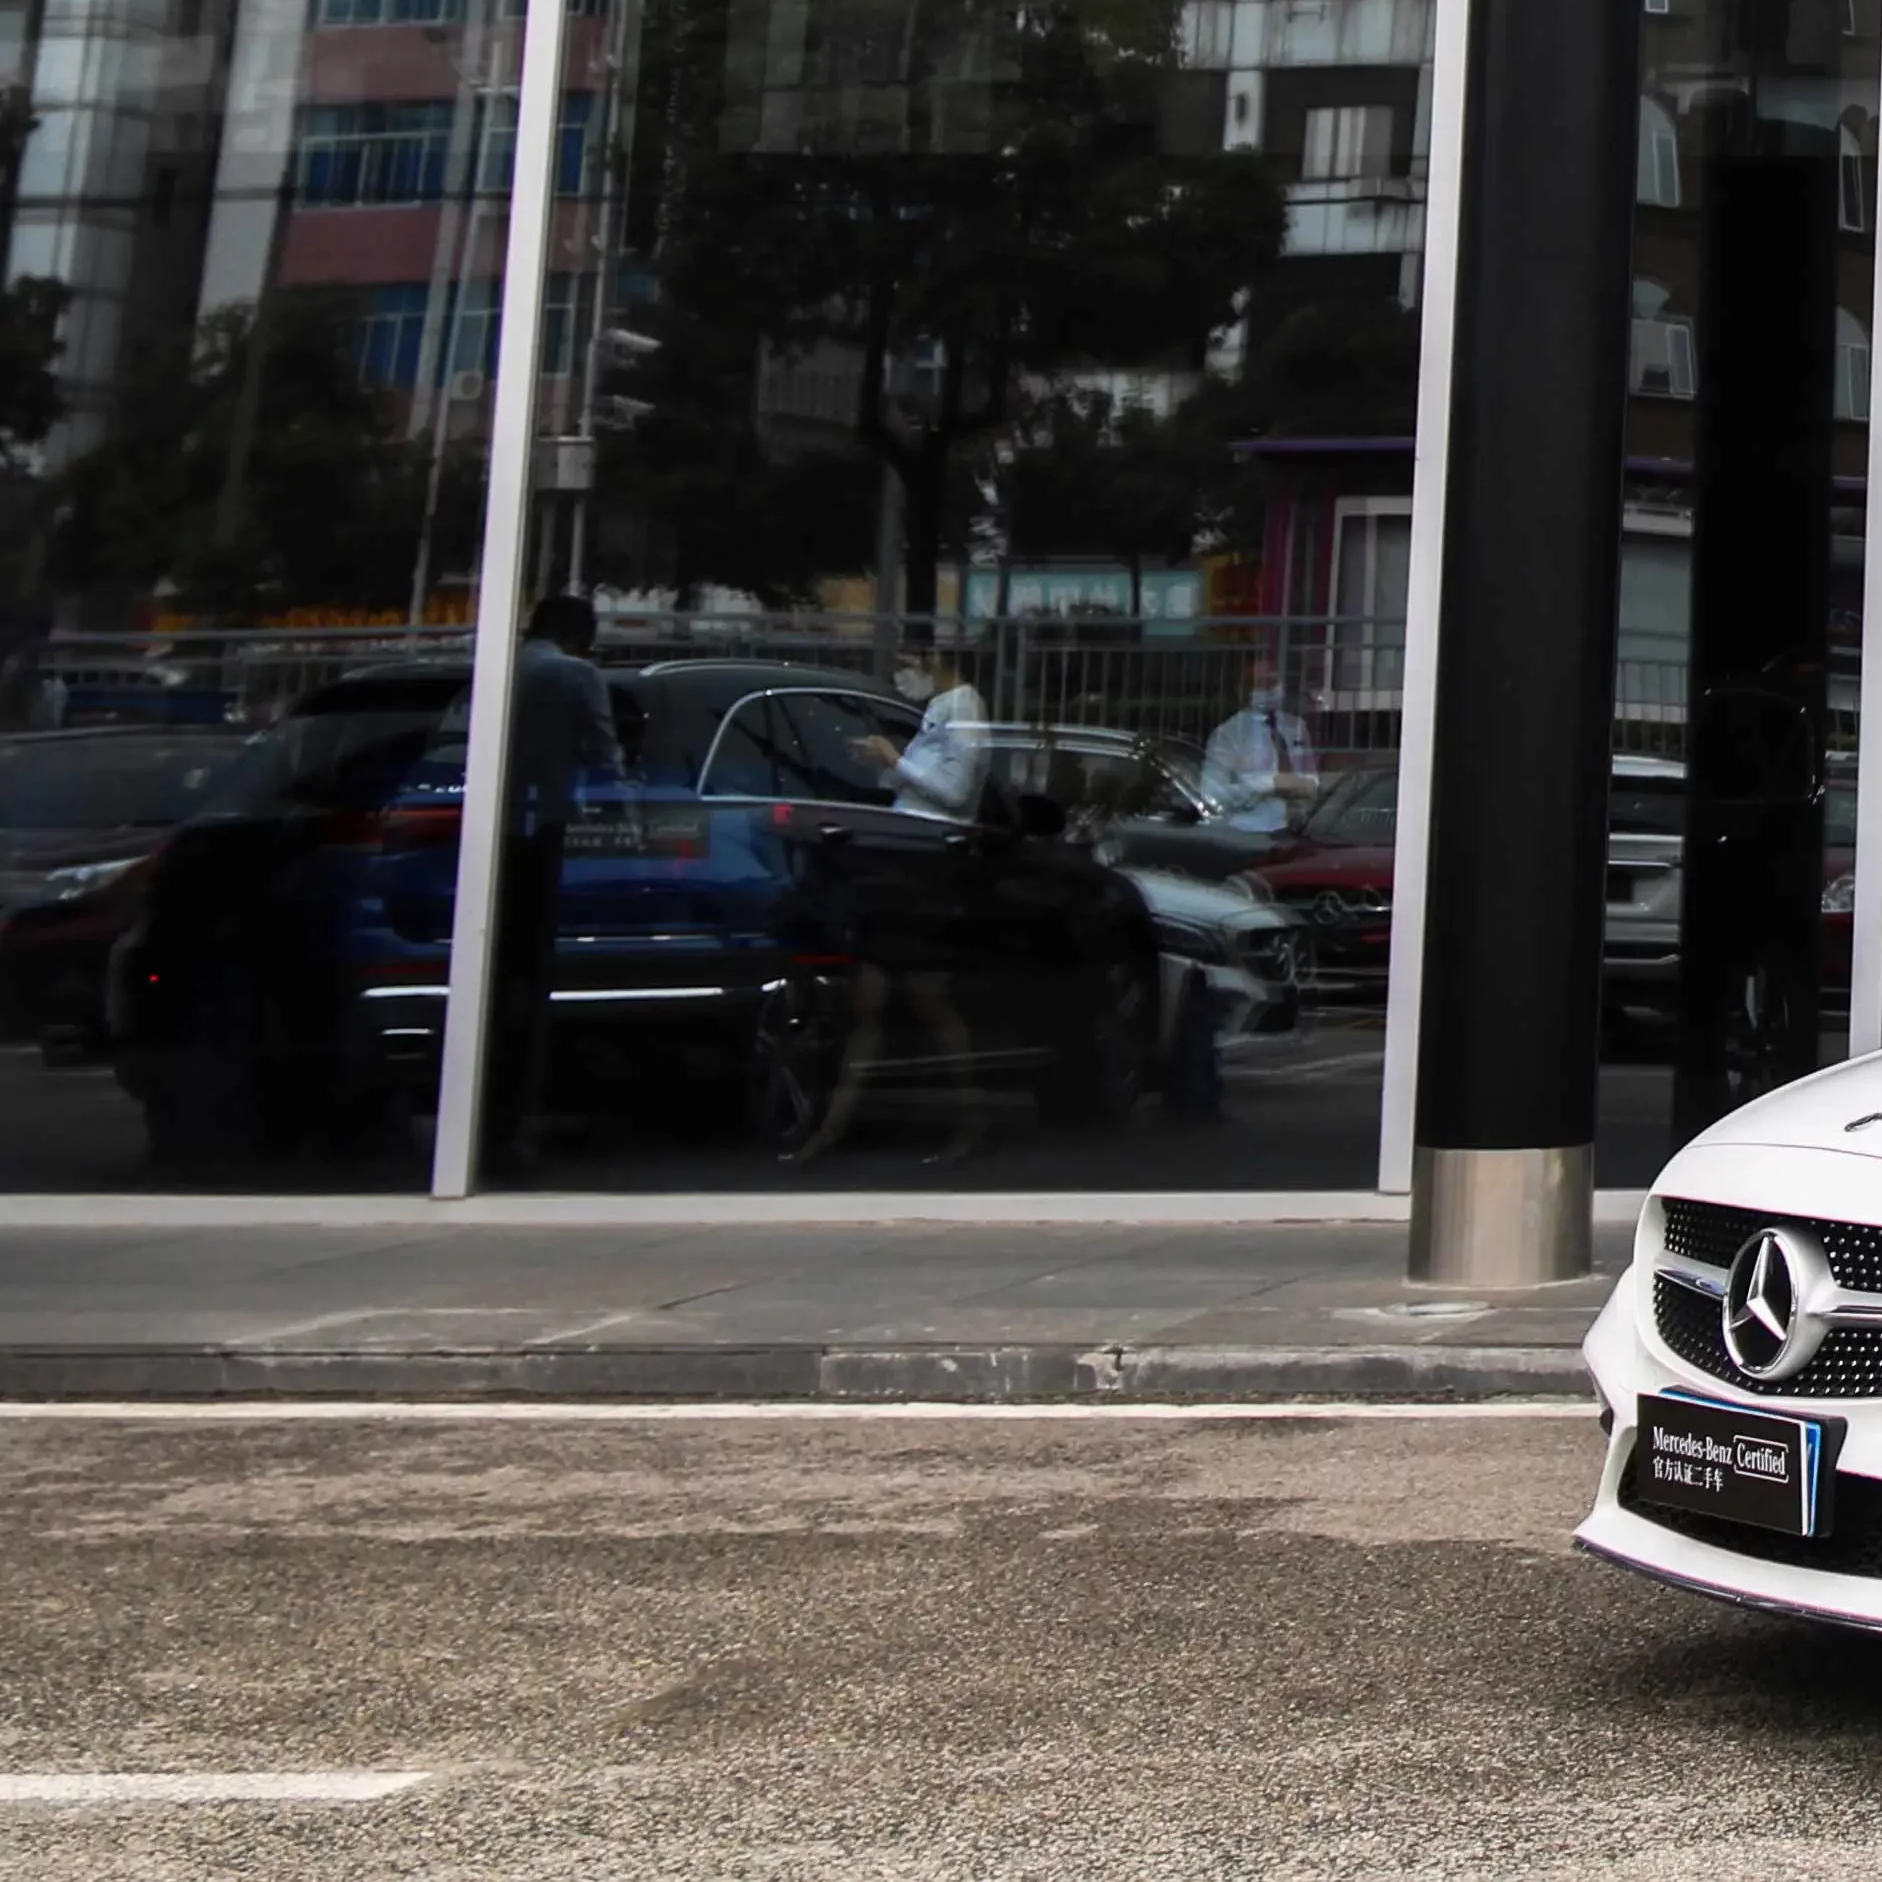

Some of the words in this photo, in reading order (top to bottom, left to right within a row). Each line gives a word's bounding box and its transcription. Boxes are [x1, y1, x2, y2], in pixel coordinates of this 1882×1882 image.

[1652, 1425, 1733, 1465] Mercedes-Benz
[1736, 1442, 1786, 1476] Certified
[1652, 1455, 1724, 1493] 官方认证二手车
